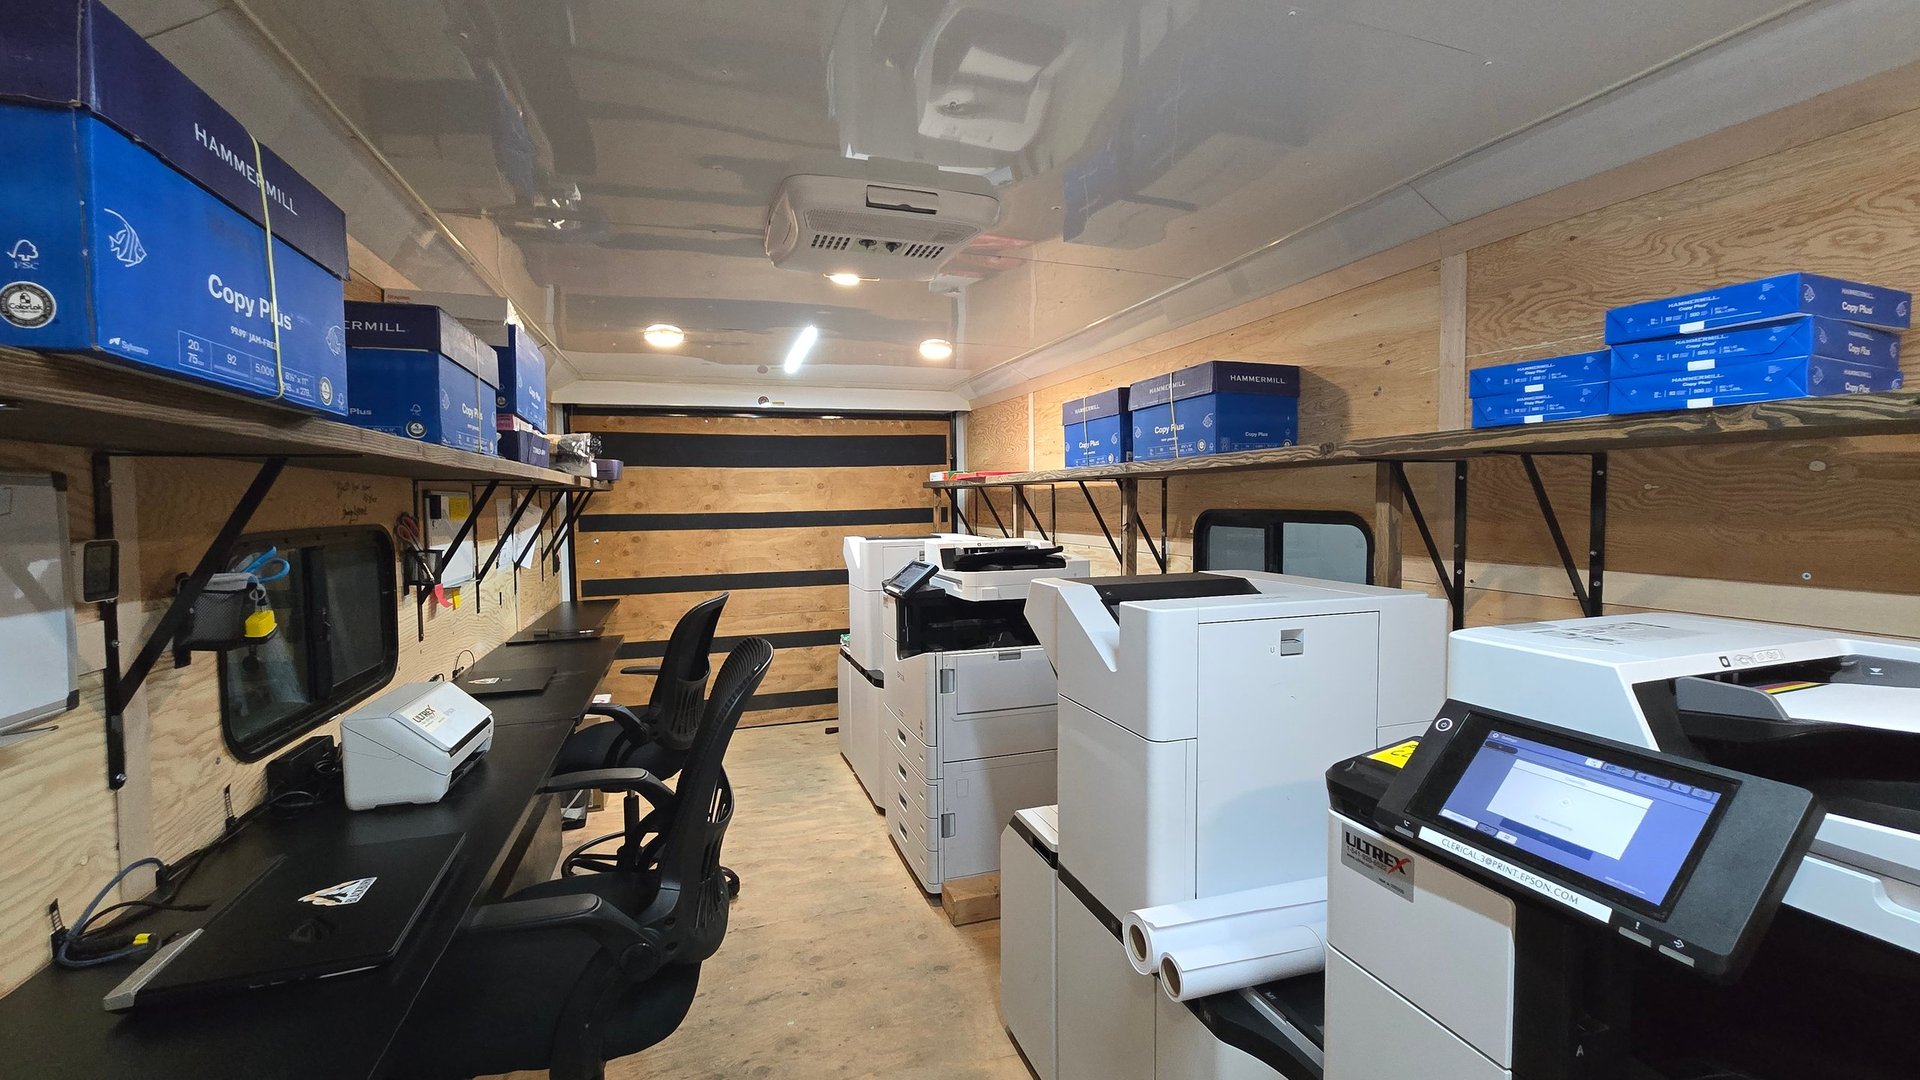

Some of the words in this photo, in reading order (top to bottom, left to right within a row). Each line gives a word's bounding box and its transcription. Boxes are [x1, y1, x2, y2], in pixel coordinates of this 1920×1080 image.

[208, 274, 255, 317] Copy
[1842, 302, 1858, 313] Copy
[1859, 304, 1872, 314] Plus
[344, 320, 405, 333] ERMILL
[226, 353, 238, 366] 92
[1230, 374, 1286, 384] HAMMERMILL
[1149, 380, 1186, 395] HAMMEMILL
[1845, 382, 1859, 393] Copy
[350, 407, 372, 415] Plus
[1154, 426, 1170, 435] Copy
[1170, 424, 1185, 432] Pus
[1346, 832, 1411, 876] ULTREX
[1441, 838, 1579, 905] CLERICAL.3@PRINT.EPSON.COM
[1576, 1044, 1584, 1057] A
